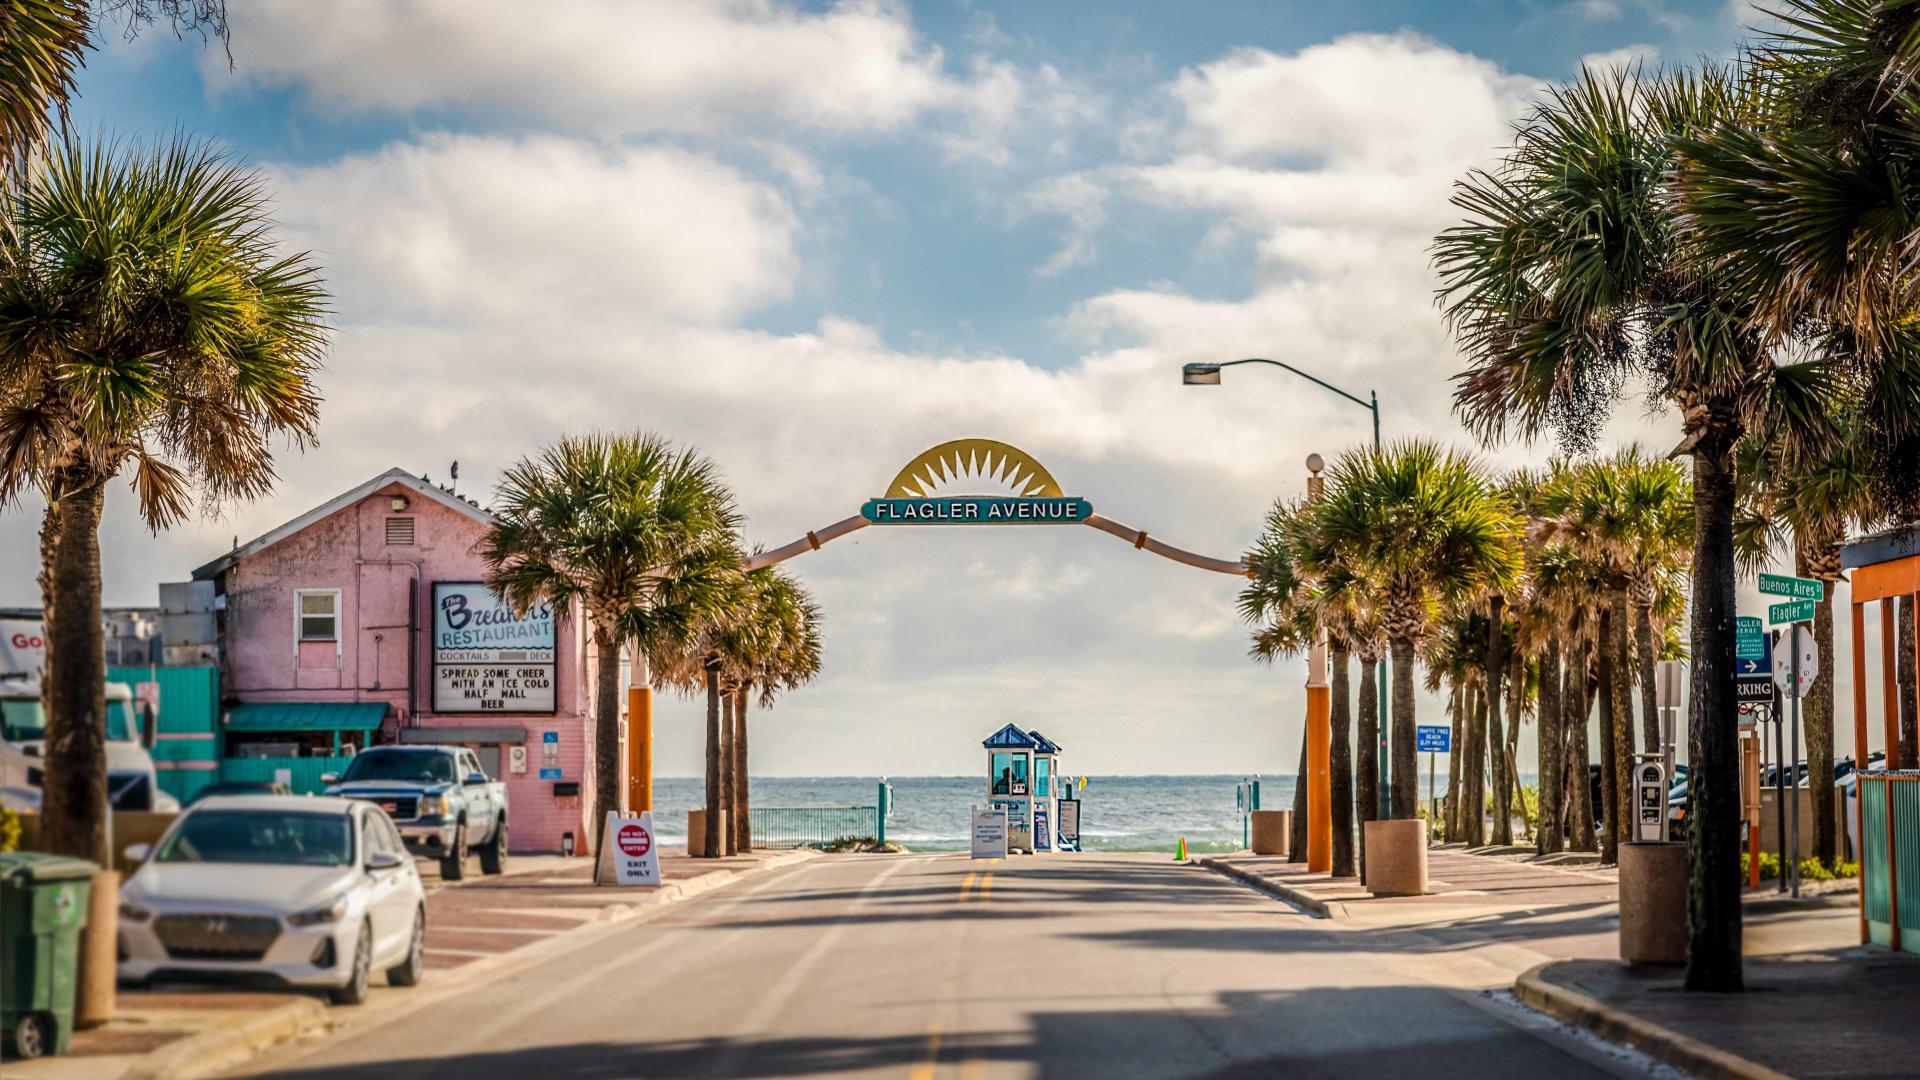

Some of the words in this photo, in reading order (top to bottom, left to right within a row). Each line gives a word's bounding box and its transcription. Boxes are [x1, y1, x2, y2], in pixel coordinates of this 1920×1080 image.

[876, 503, 978, 519] FLAGLER
[988, 503, 1078, 519] AVENUE
[1760, 577, 1790, 594] Buenos
[1793, 581, 1815, 597] Aires
[1816, 584, 1822, 592] St
[445, 596, 461, 607] The
[441, 594, 550, 629] Breakrs
[1772, 604, 1801, 623] Flagler
[1803, 602, 1812, 610] Ave
[1736, 619, 1761, 628] AGLER
[442, 621, 550, 647] RESTAURANT
[12, 633, 42, 649] Go
[440, 651, 490, 661] COCKTAILS
[530, 651, 551, 661] DECK
[442, 668, 480, 679] SPREAD
[484, 668, 510, 679] SOME
[516, 668, 546, 679] CHEER
[451, 679, 475, 689] WITH
[482, 679, 495, 689] AN
[502, 679, 519, 689] ICE
[524, 679, 549, 689] COLD
[1737, 683, 1771, 696] RKING
[464, 690, 489, 699] HALF
[501, 690, 527, 699] WALL
[481, 699, 505, 709] BEER
